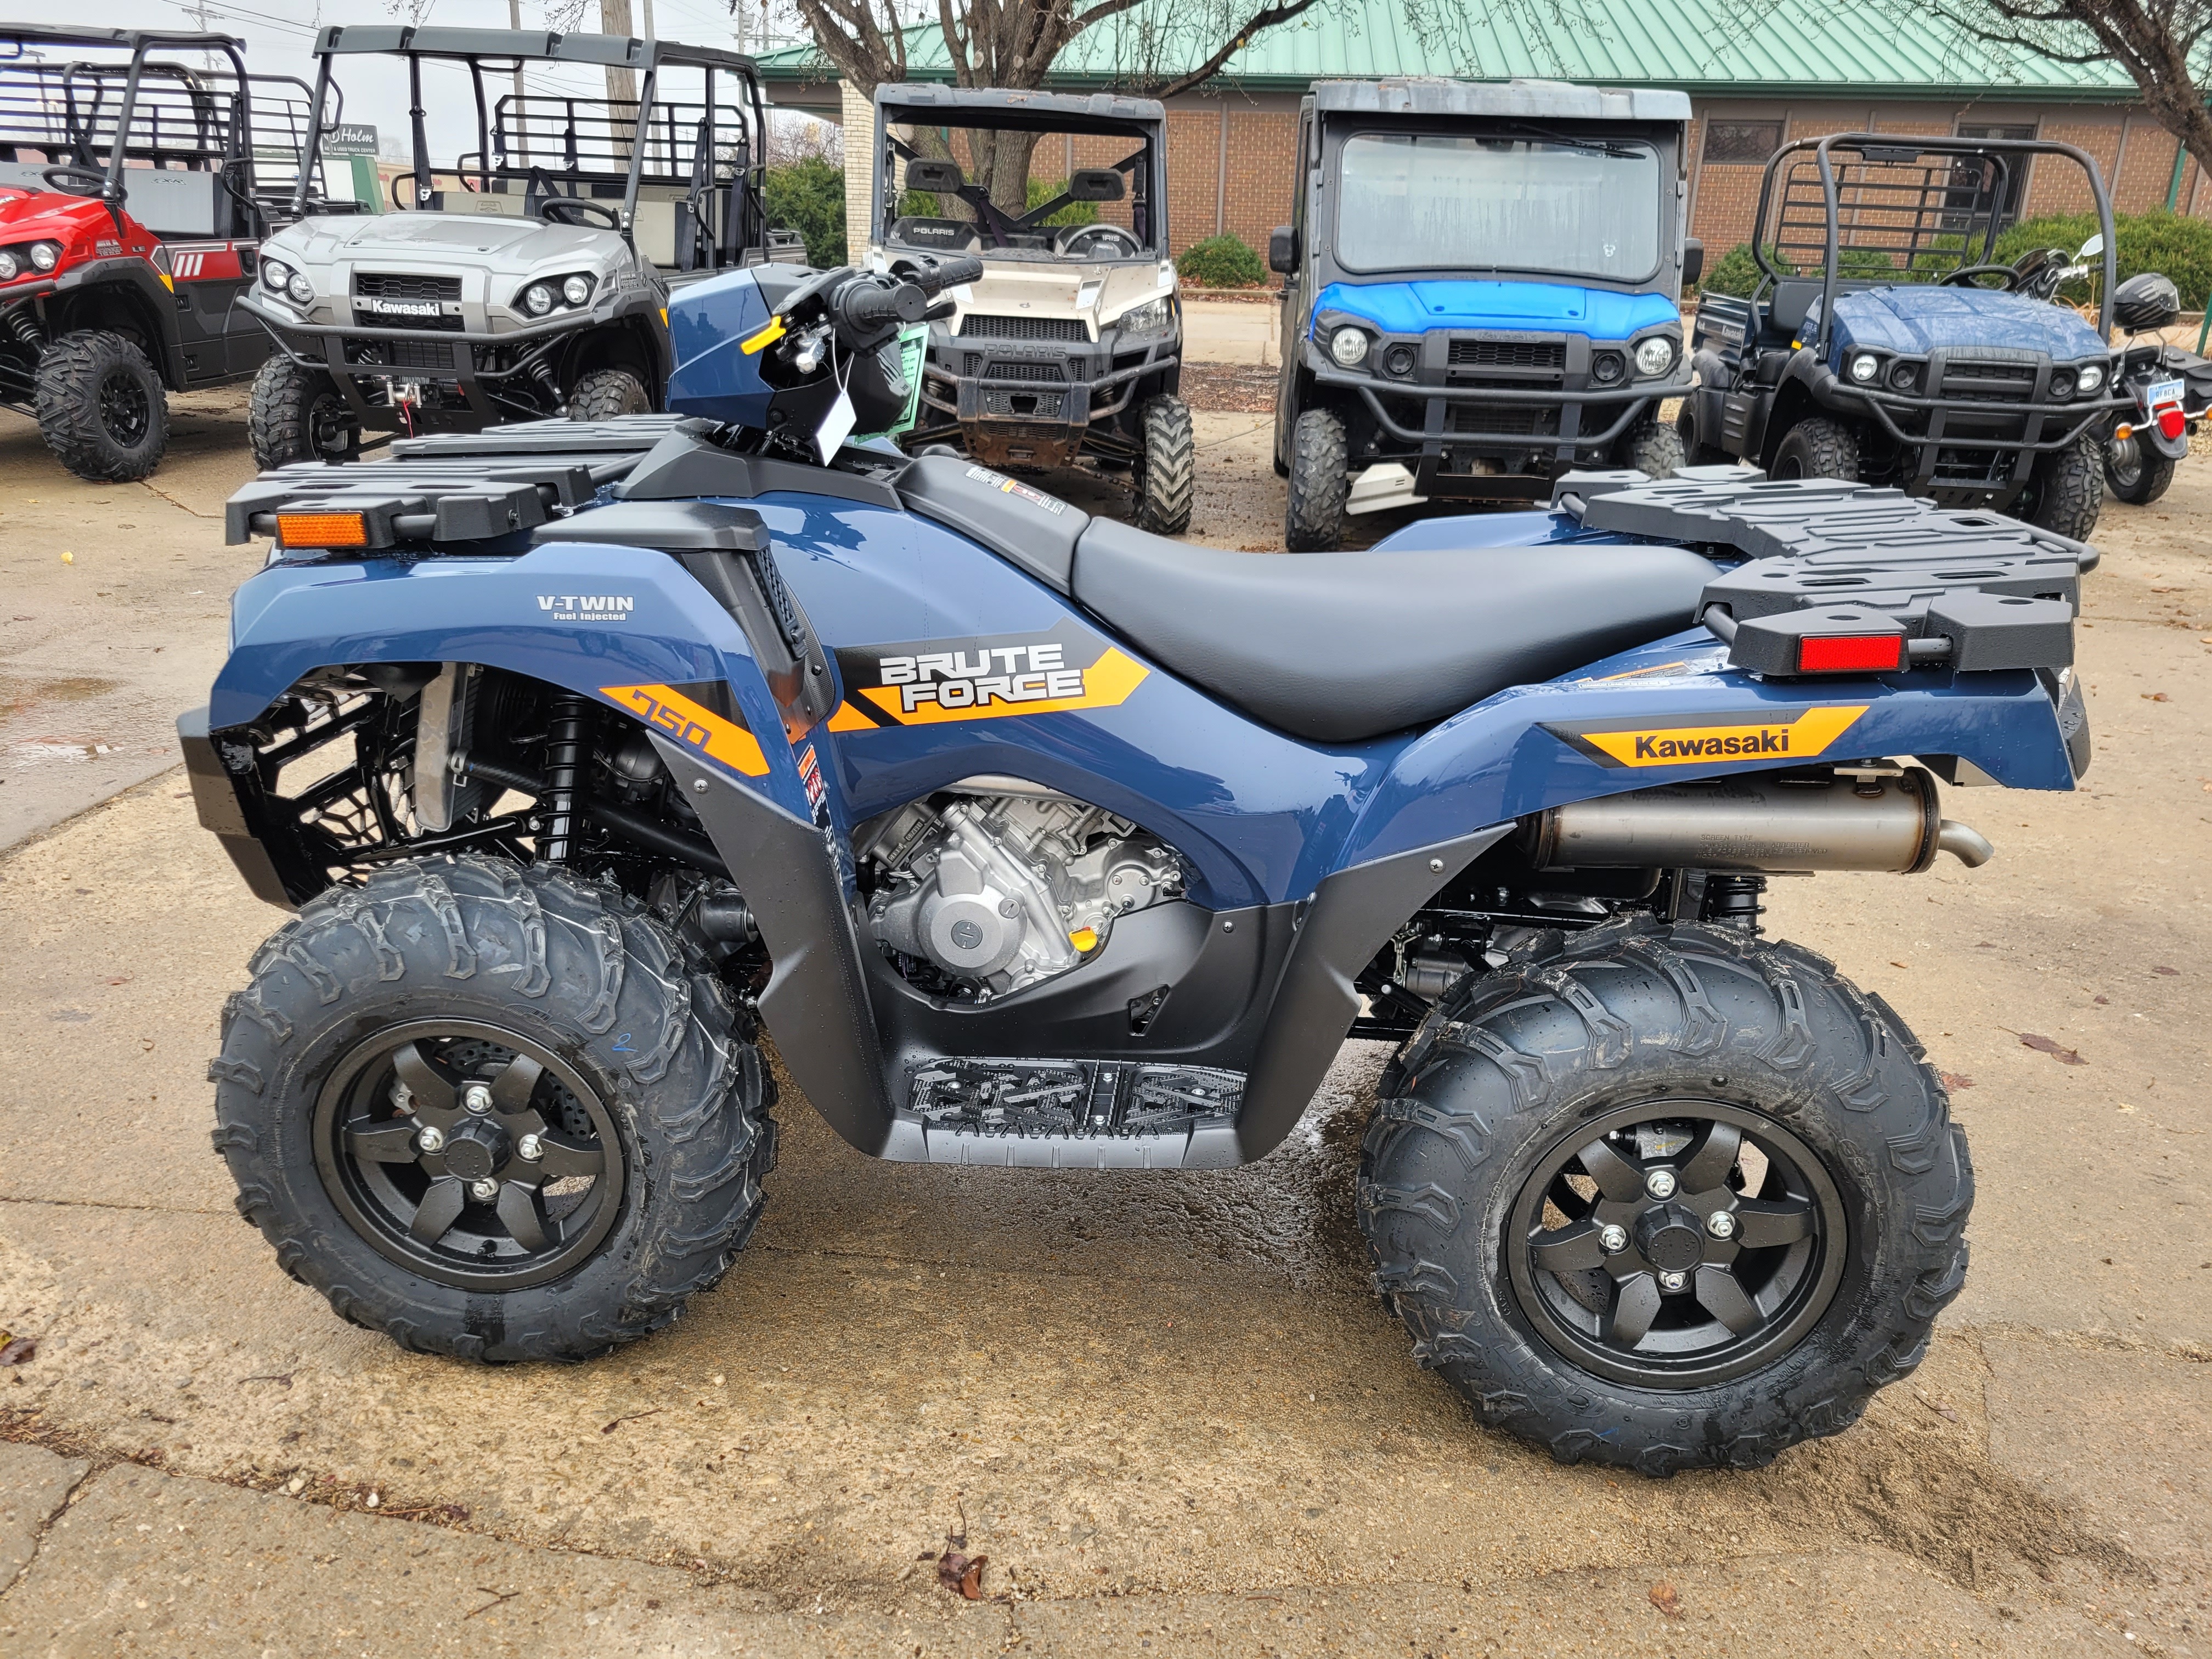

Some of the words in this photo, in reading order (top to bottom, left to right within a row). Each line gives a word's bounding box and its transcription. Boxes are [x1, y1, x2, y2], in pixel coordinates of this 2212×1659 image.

[341, 127, 374, 143] Holm
[913, 227, 955, 236] POLARIS
[372, 300, 440, 316] Kawasaki
[984, 343, 1066, 359] POLARIS
[536, 596, 634, 611] V-TWIN
[554, 612, 577, 620] Fuel
[580, 612, 627, 622] Injected
[879, 643, 1065, 685] BRUTE
[901, 669, 1084, 713] FORCE
[632, 689, 713, 751] 750
[1635, 729, 1789, 759] Kawasaki
[612, 1032, 639, 1052] 2
[1493, 1343, 1609, 1418] CST
